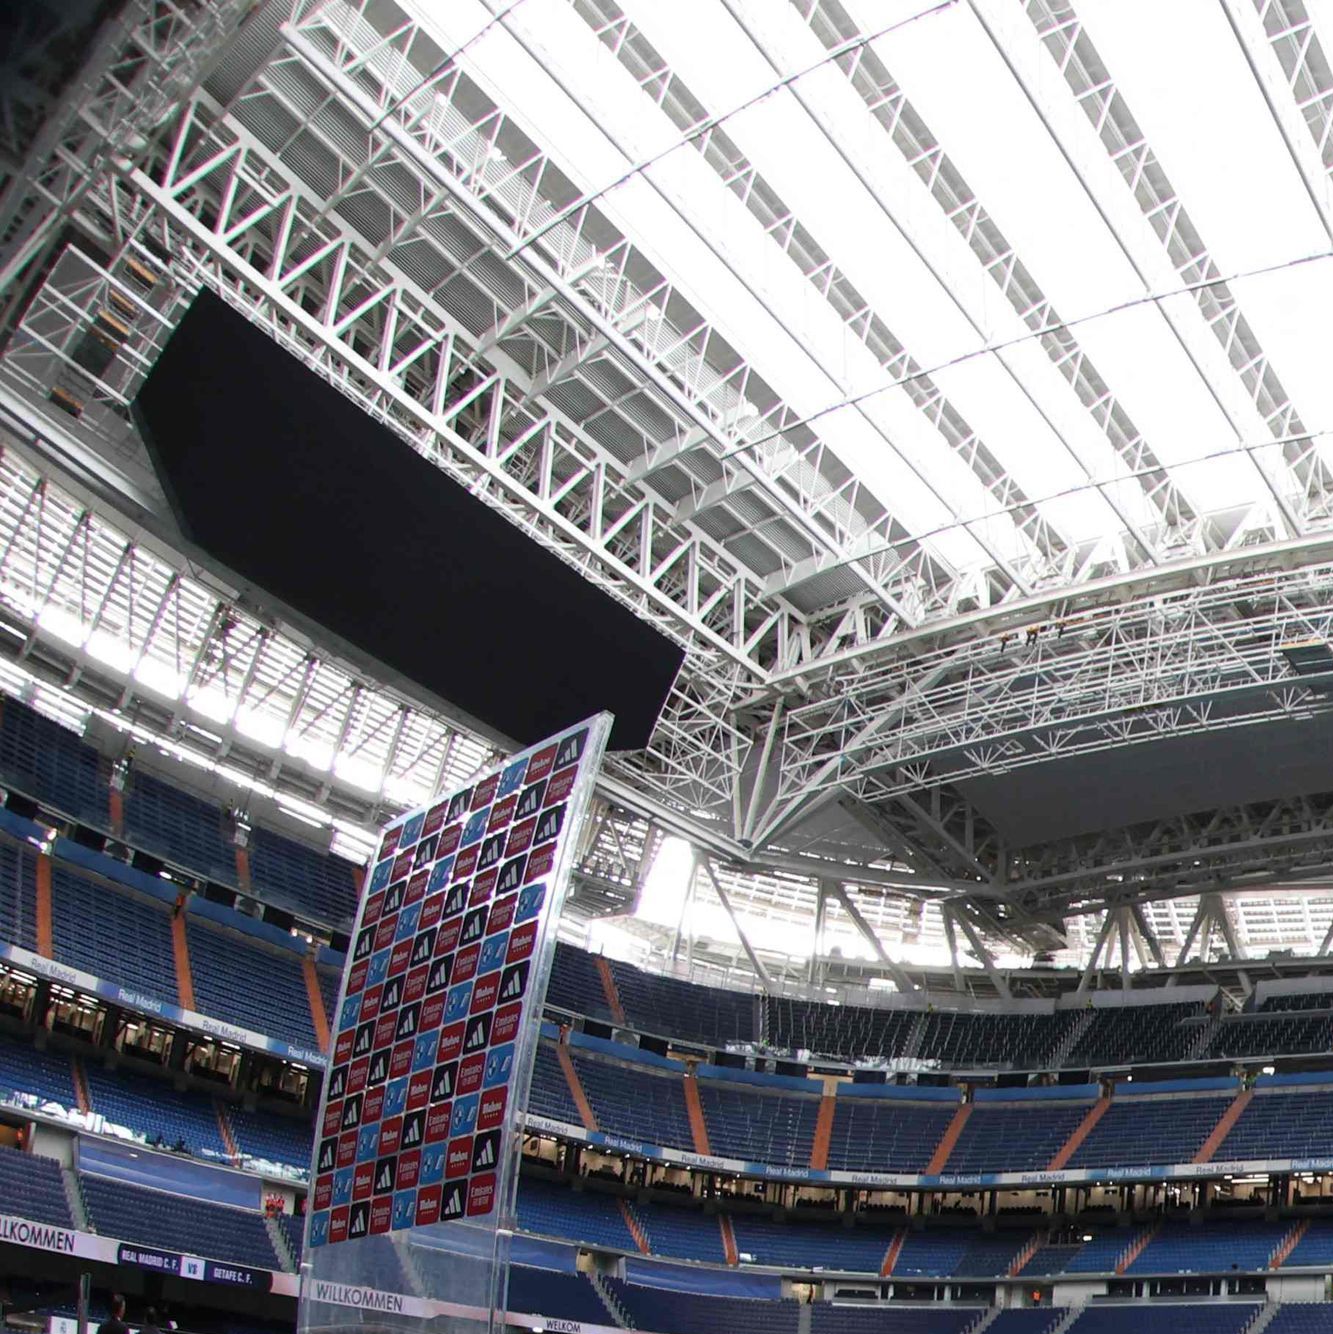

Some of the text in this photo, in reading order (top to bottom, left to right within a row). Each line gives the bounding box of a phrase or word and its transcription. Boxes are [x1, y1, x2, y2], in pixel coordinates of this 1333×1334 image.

[0, 1218, 75, 1253] LKOMMEN
[316, 1282, 403, 1311] WILLKOMMEN
[545, 1319, 582, 1334] WELKOM
